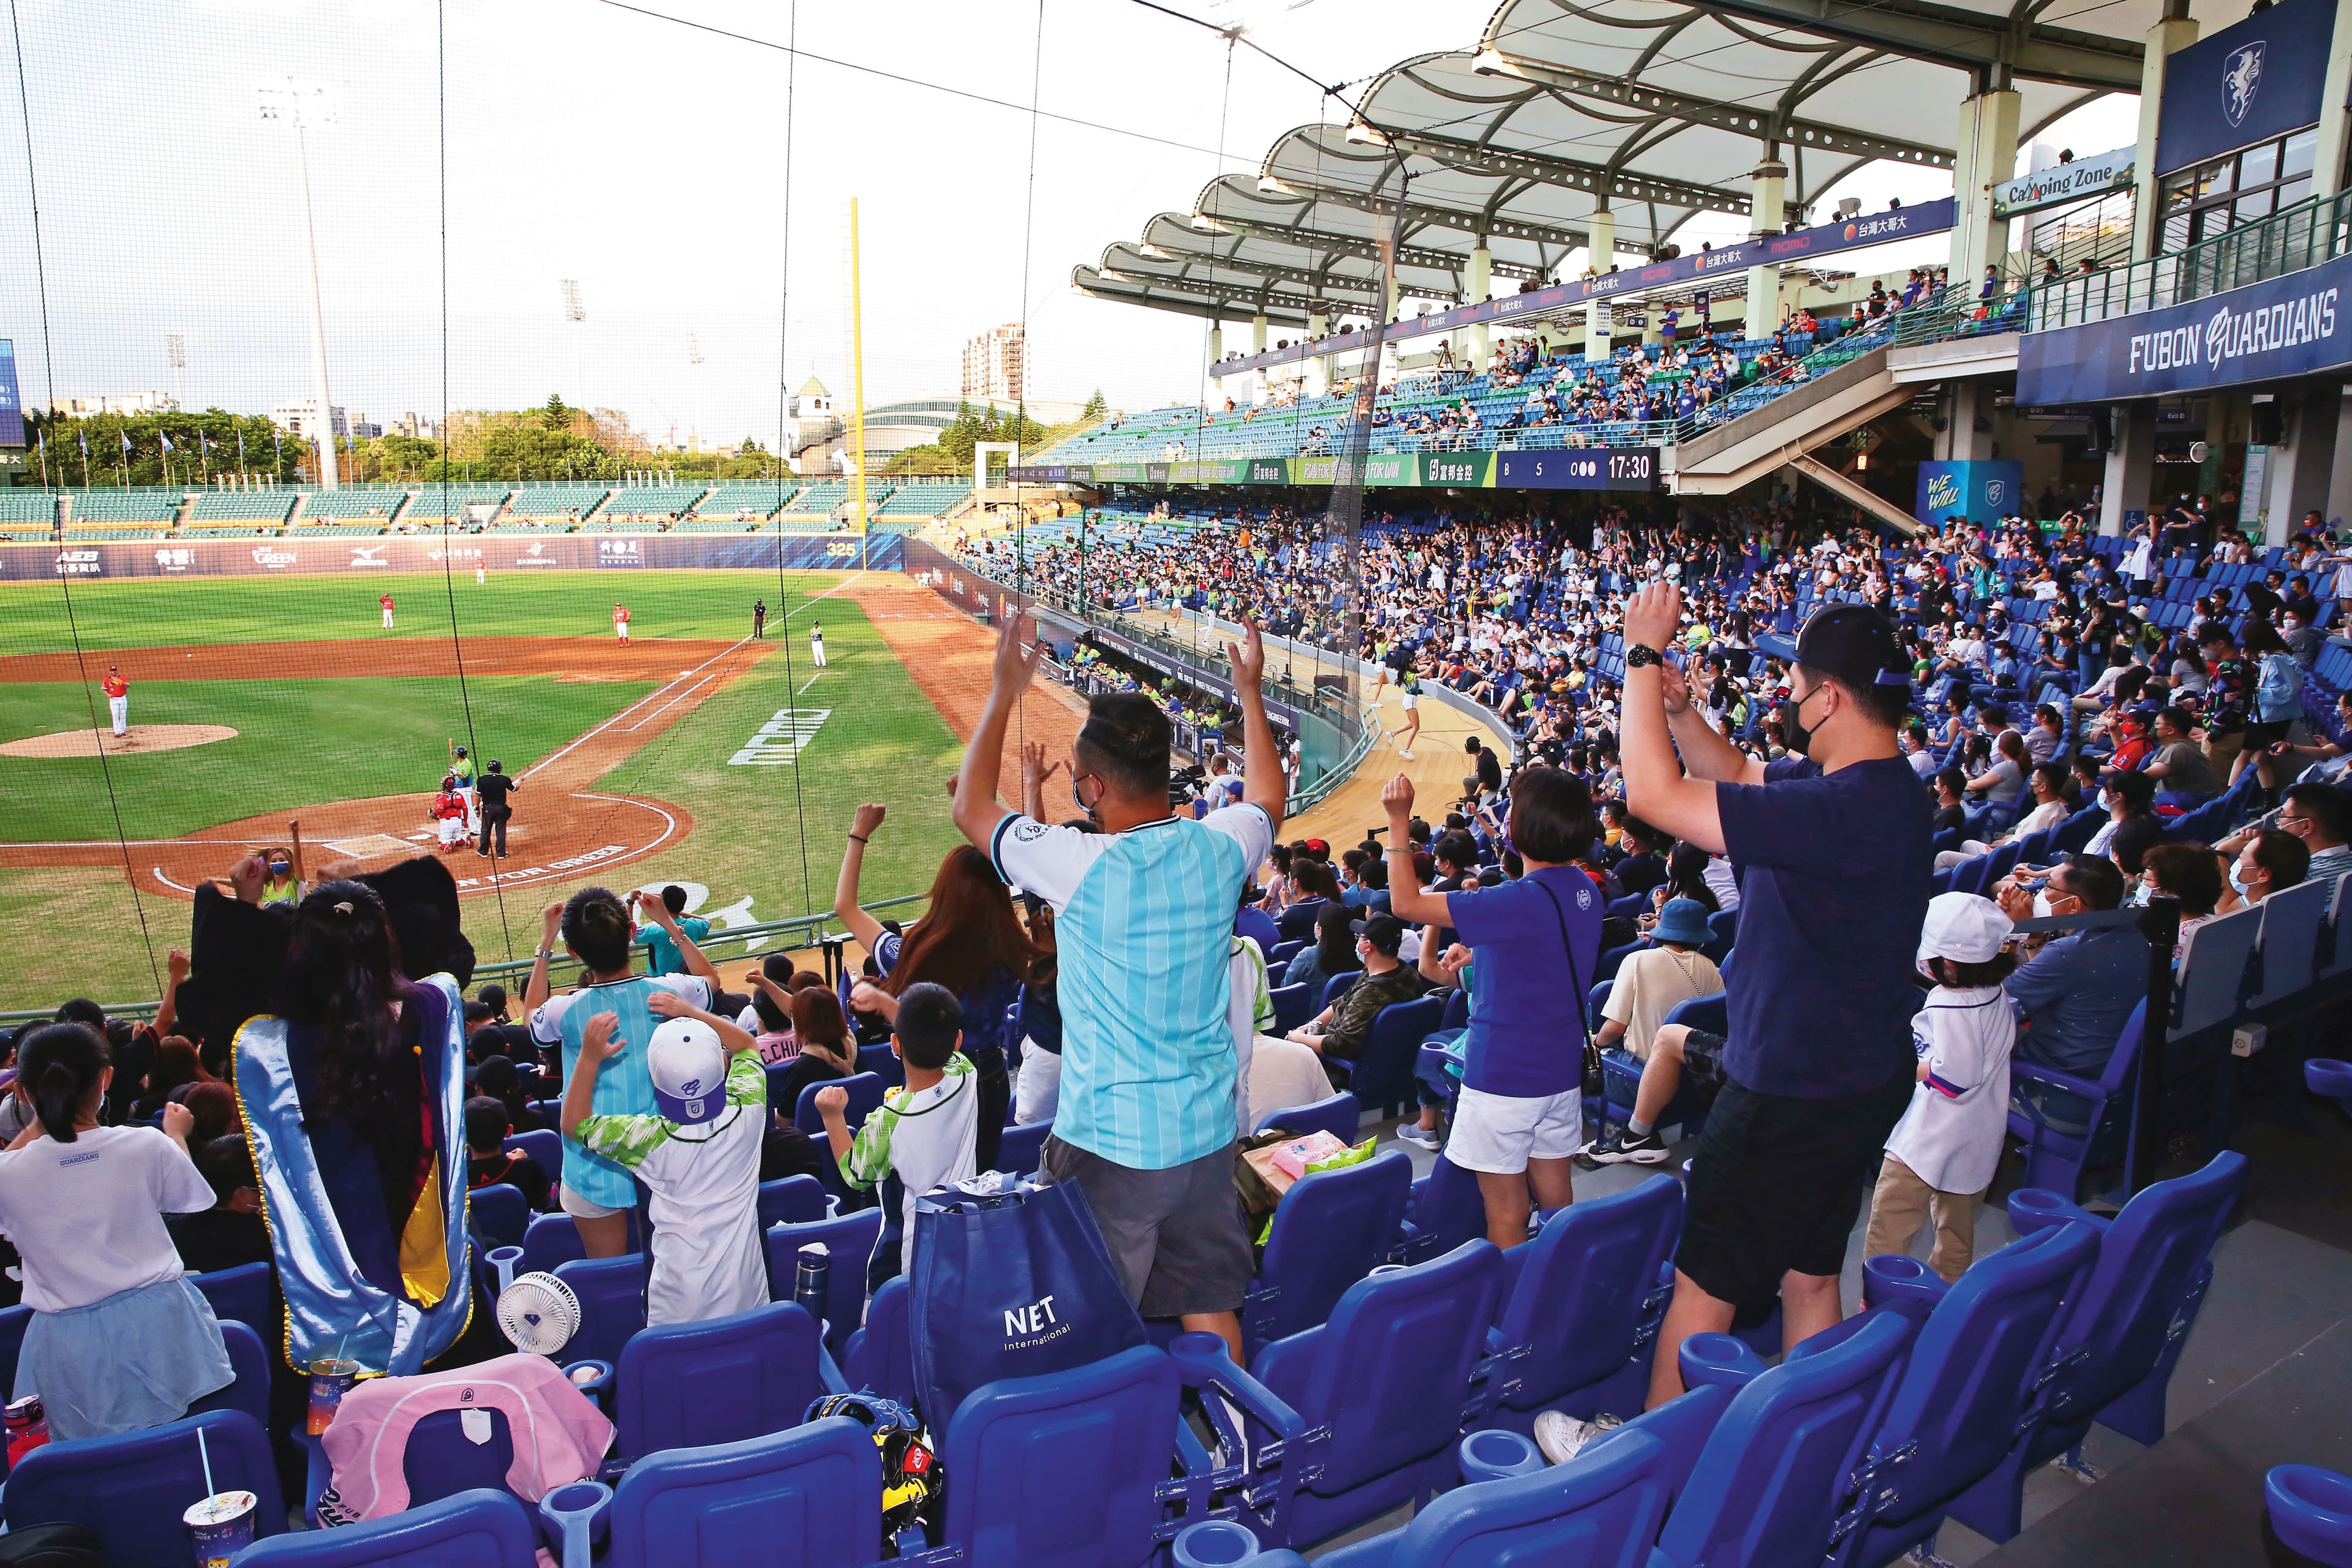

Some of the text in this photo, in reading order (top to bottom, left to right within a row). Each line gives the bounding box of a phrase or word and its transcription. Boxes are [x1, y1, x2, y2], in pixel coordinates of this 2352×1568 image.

[2009, 165, 2113, 203] Camping Zone
[1858, 215, 1907, 238] 台灣大哥大
[1706, 250, 1741, 269] 台灣大哥大
[1591, 277, 1619, 293] 台灣大哥大
[2129, 288, 2337, 374] FUBON GUARDIANS
[1304, 464, 1317, 479] RUN
[1370, 462, 1384, 478] FOR
[1385, 461, 1400, 479] WIN
[1440, 464, 1473, 481] 富邦金控
[1504, 462, 1509, 476] B
[1536, 462, 1542, 476] S
[1608, 455, 1649, 478] 17:30
[1928, 474, 1953, 494] WE
[1928, 487, 1959, 510] WILL
[254, 552, 296, 564] GREEN
[826, 543, 856, 557] 325
[485, 867, 551, 883] FOR
[548, 845, 629, 869] GREEN
[60, 1153, 99, 1166] GUARDIANS
[1005, 1295, 1056, 1336] NET
[1005, 1323, 1071, 1351] International
